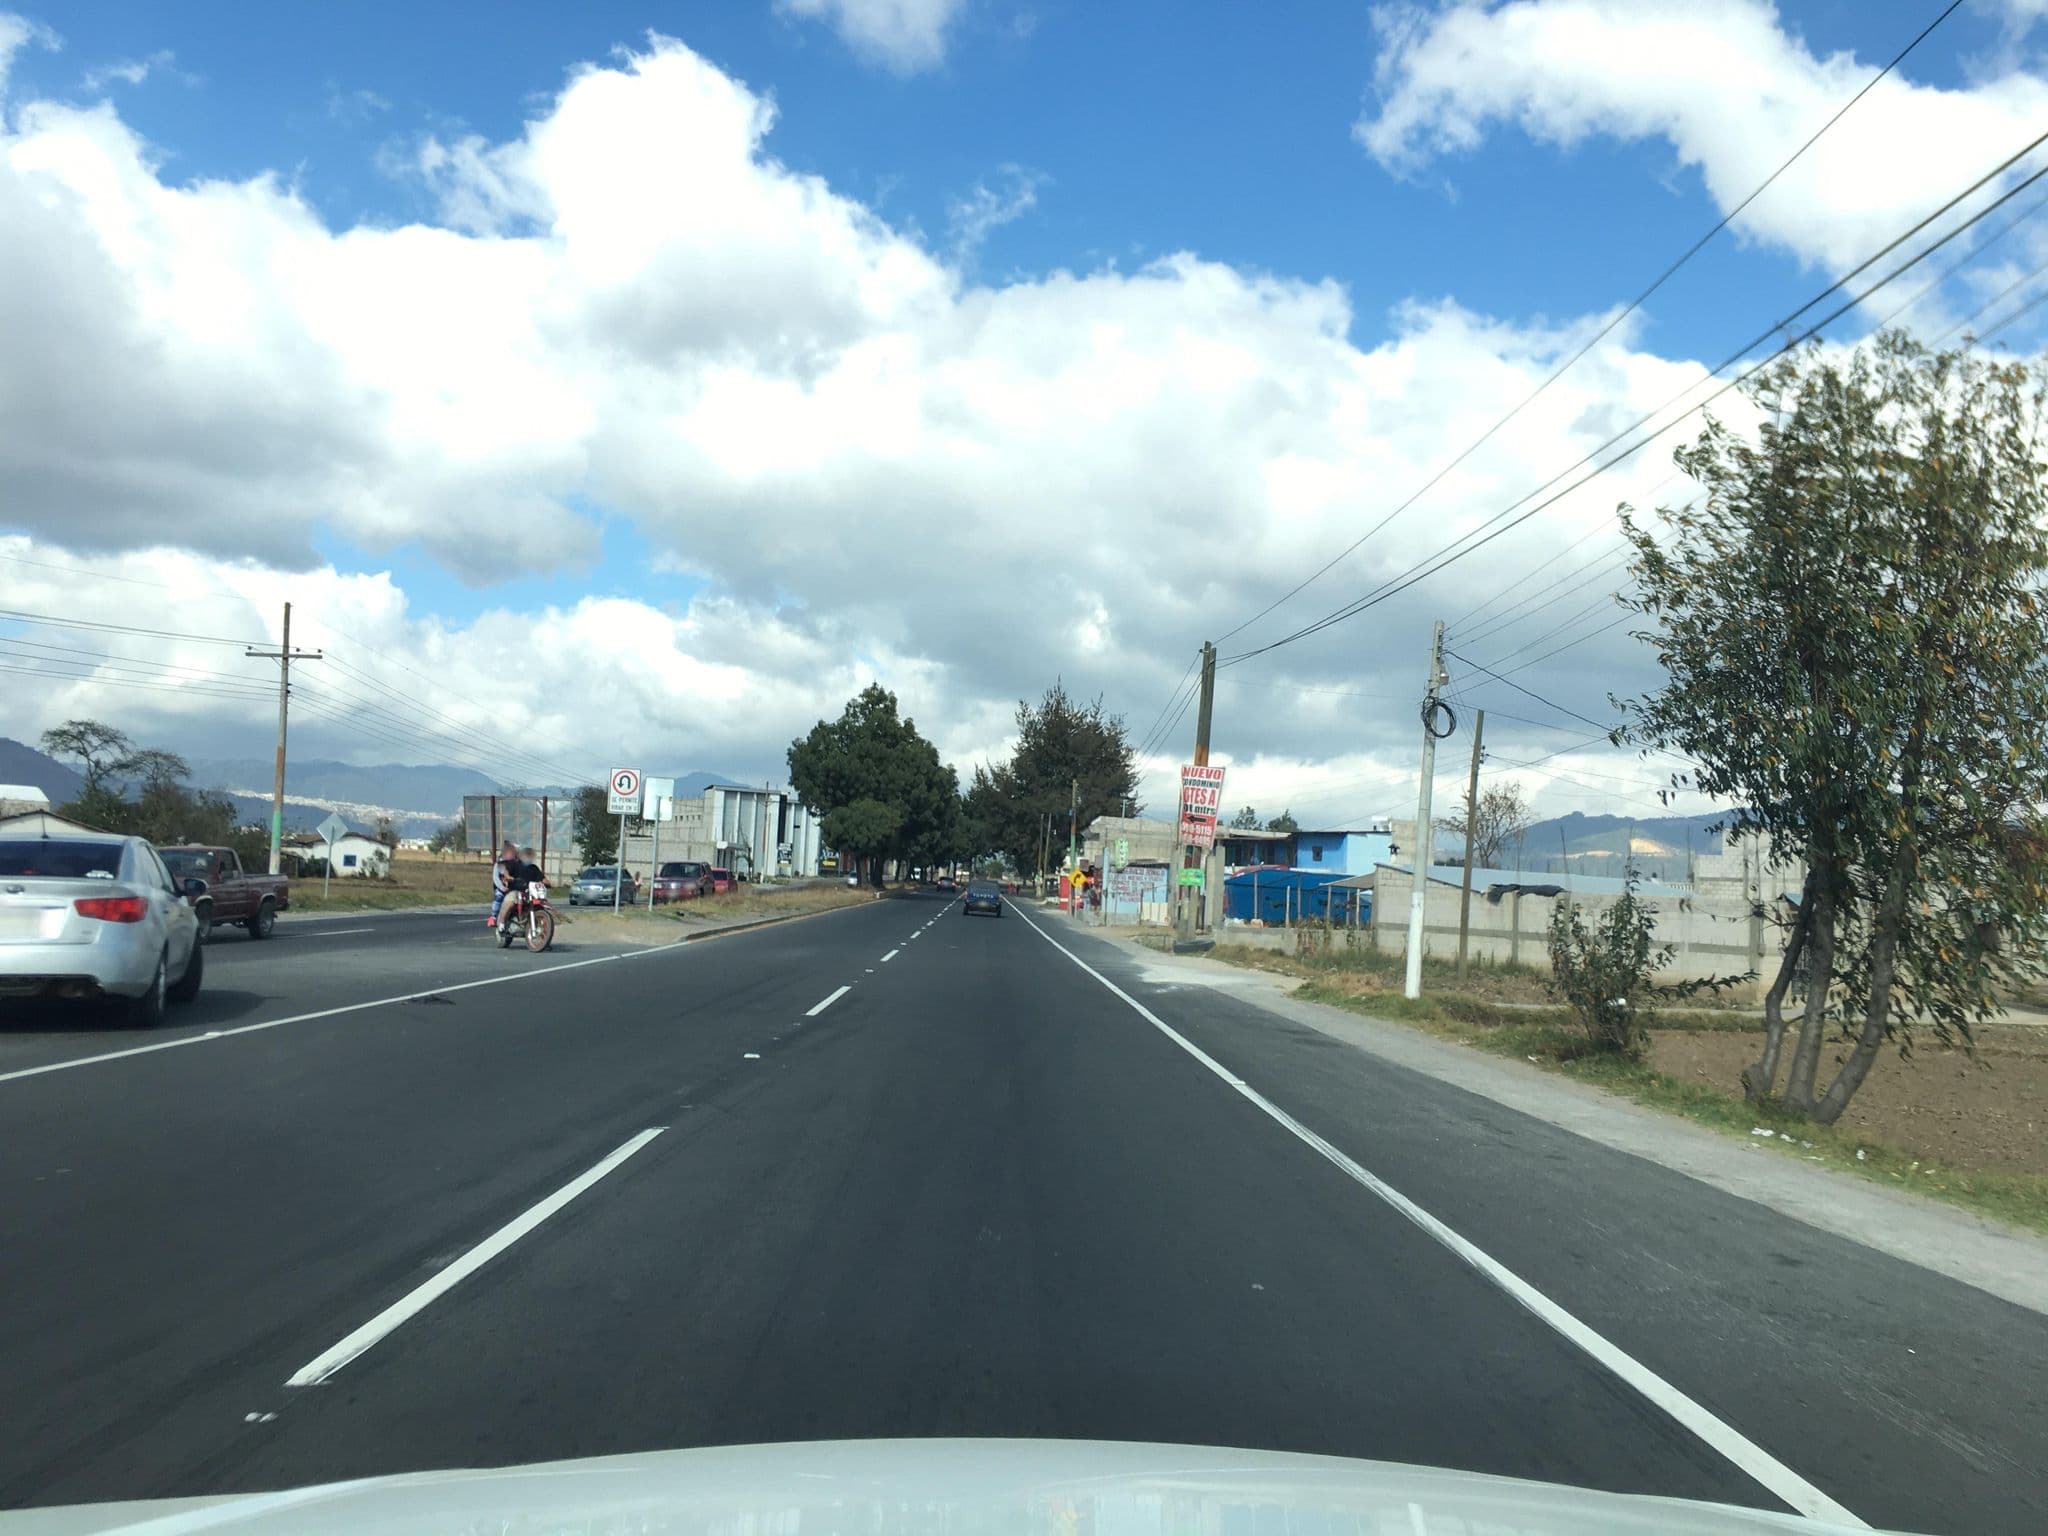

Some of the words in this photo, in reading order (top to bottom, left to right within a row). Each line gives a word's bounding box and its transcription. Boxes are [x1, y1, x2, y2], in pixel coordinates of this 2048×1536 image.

[1183, 767, 1221, 780] NUEVO
[1183, 787, 1207, 805] OTES
[1208, 789, 1217, 806] A
